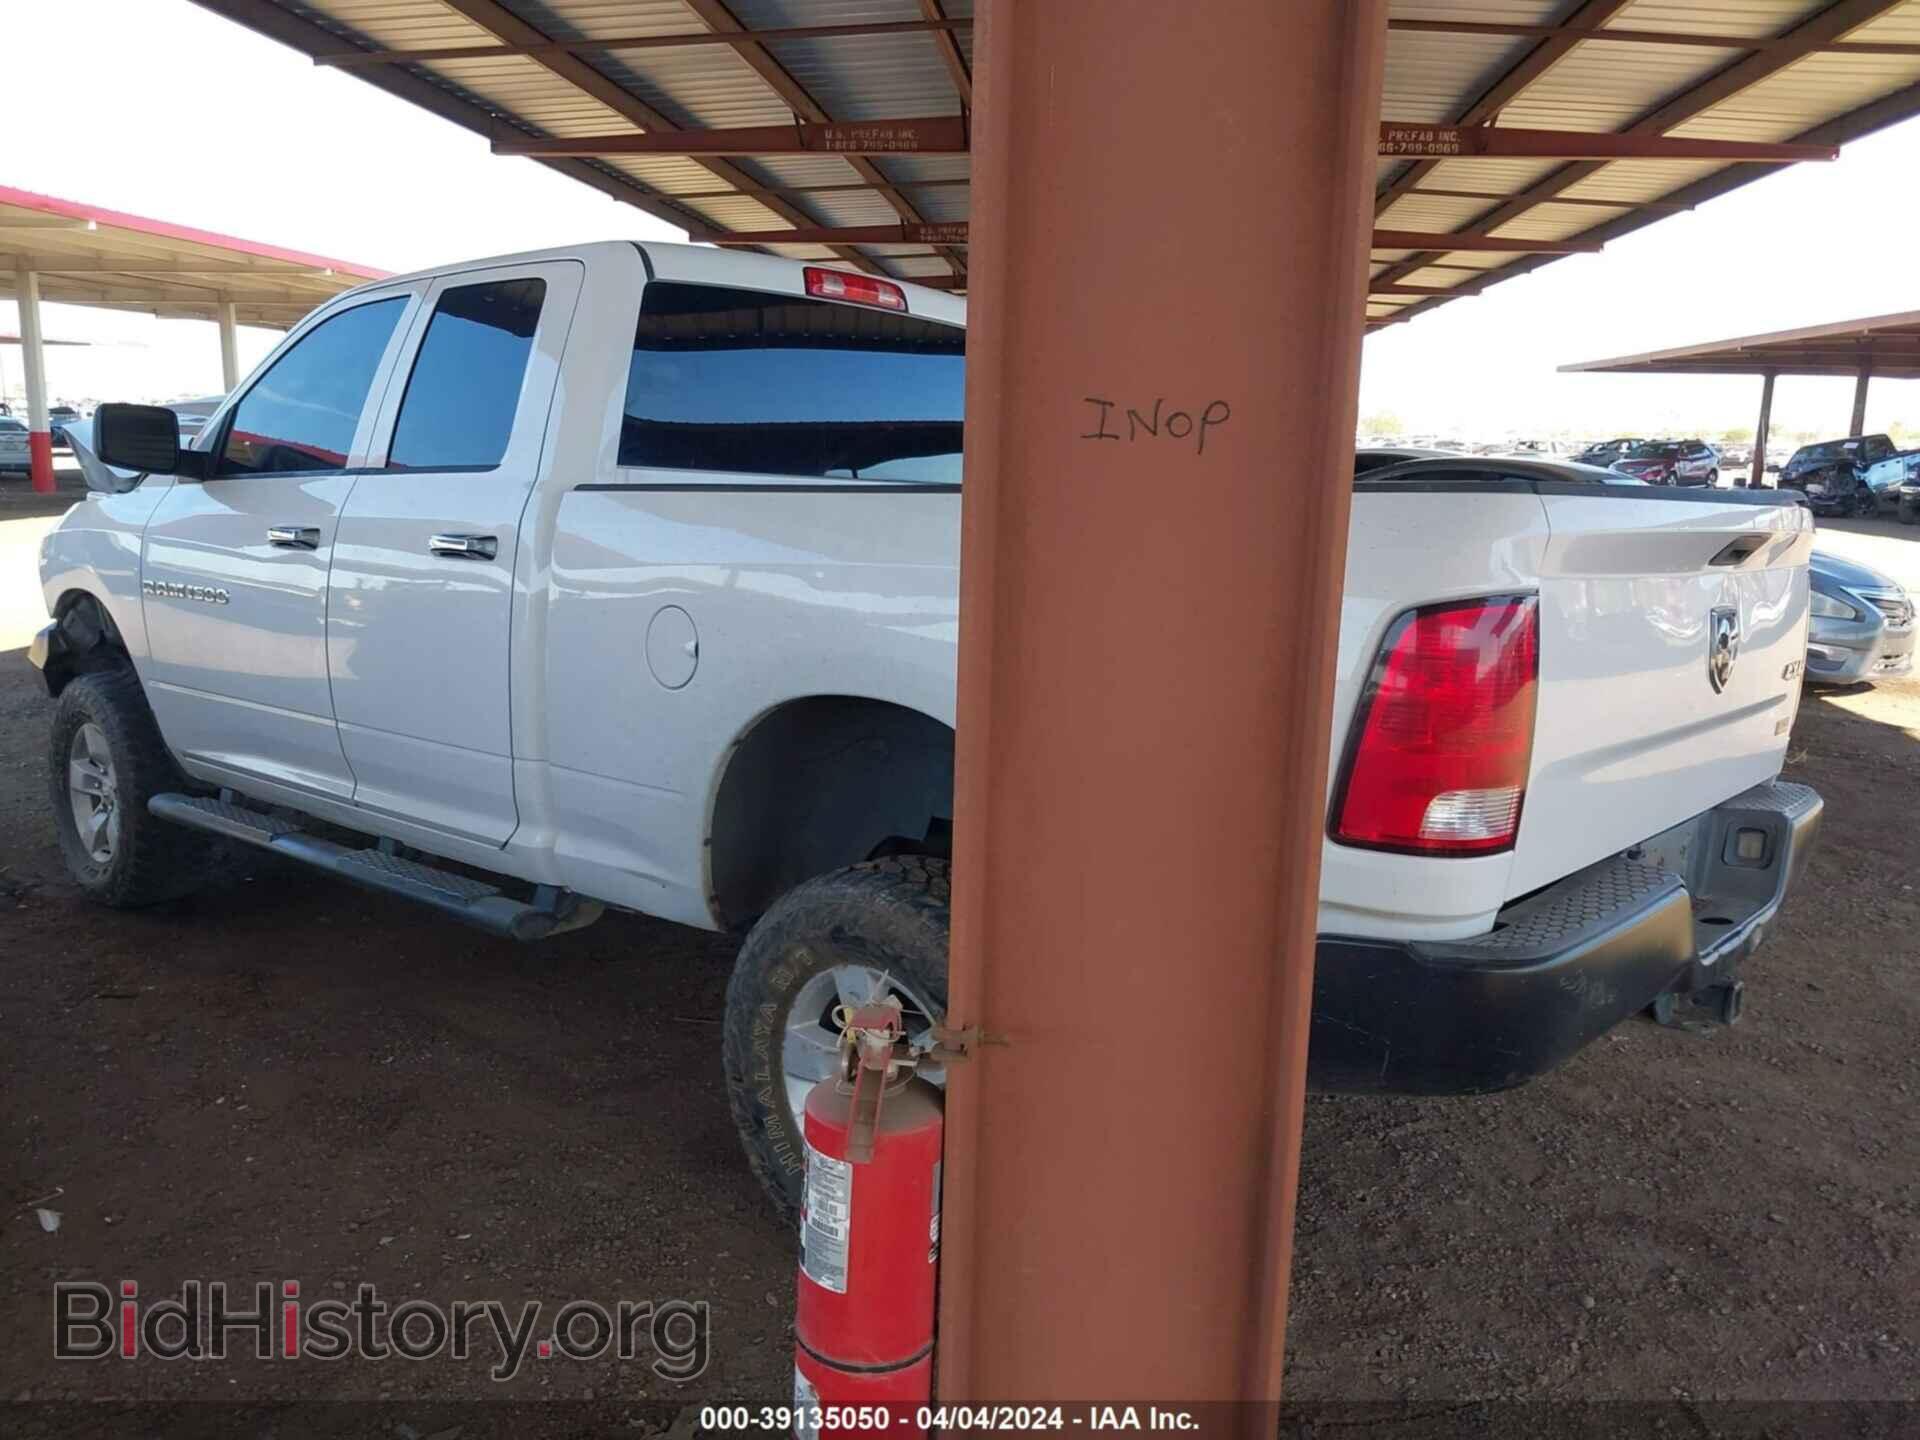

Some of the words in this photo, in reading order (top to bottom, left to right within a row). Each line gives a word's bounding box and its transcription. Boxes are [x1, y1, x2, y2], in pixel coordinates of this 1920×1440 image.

[1388, 129, 1434, 142] PREFAB
[1080, 397, 1231, 456] INOP
[752, 1004, 802, 1176] HIMALAYA
